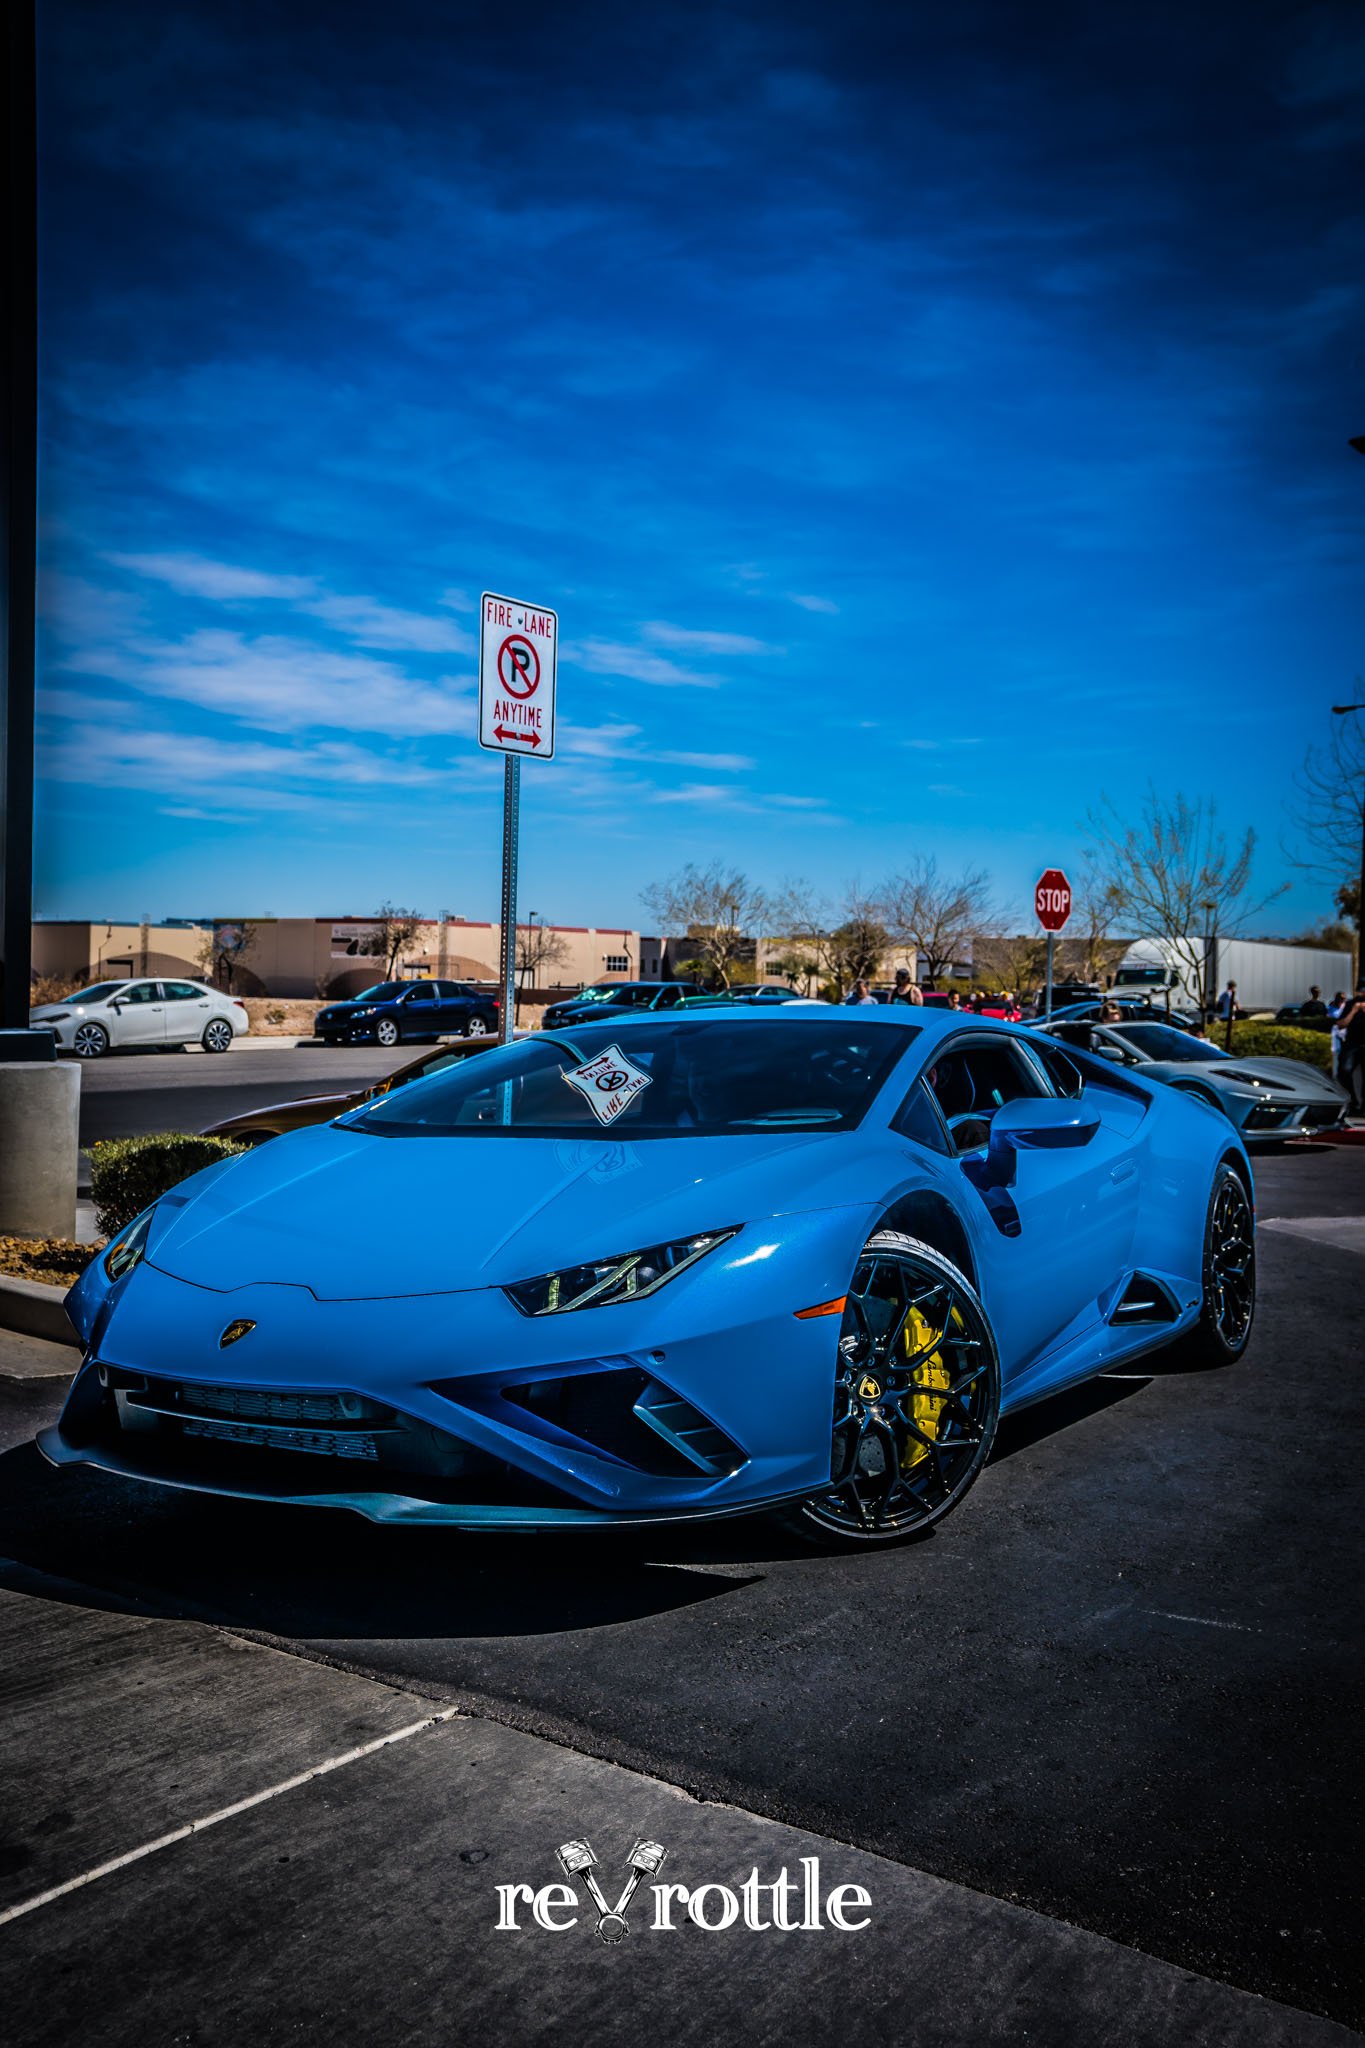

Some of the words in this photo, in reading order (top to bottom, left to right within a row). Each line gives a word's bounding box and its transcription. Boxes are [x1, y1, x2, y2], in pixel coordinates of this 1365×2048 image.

[487, 602, 513, 628] FIRE
[524, 611, 552, 638] LANE
[493, 699, 542, 728] ANYTIME
[1037, 888, 1070, 913] STOP
[927, 1359, 937, 1411] Lamboini
